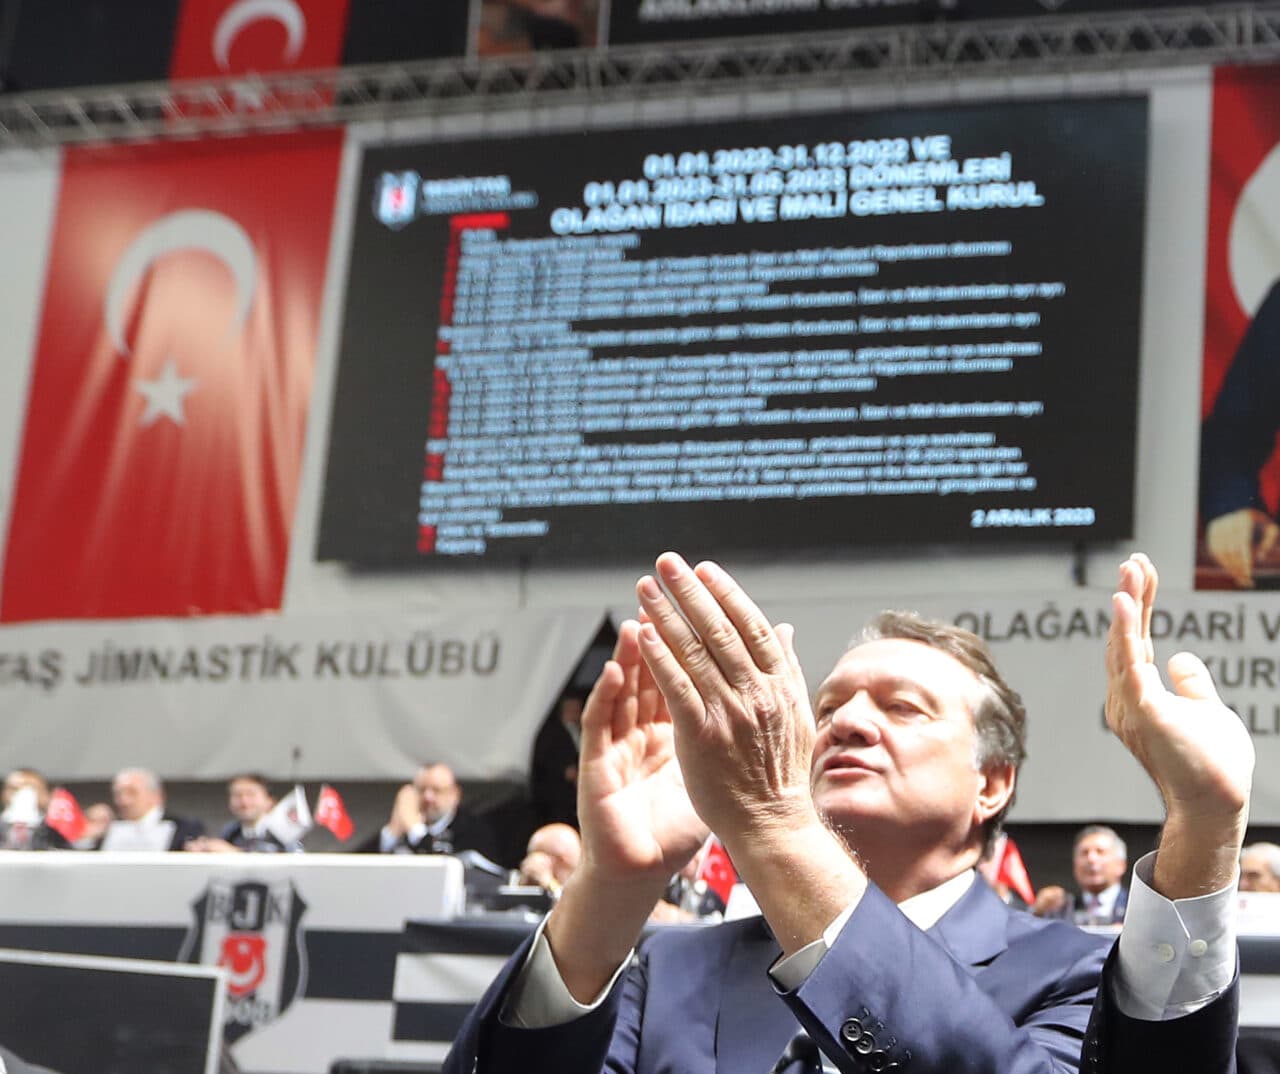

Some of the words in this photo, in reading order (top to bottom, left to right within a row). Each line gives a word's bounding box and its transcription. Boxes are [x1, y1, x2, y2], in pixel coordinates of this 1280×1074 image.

[911, 135, 951, 162] VE
[739, 196, 778, 223] VE
[849, 186, 945, 217] GENEL
[947, 181, 1046, 210] KURUL
[970, 508, 985, 528] 2
[1150, 604, 1244, 641] DARİ
[0, 648, 63, 690] AŞ
[75, 635, 301, 687] JİMNASTİK
[314, 631, 499, 680] KULÜBÜ
